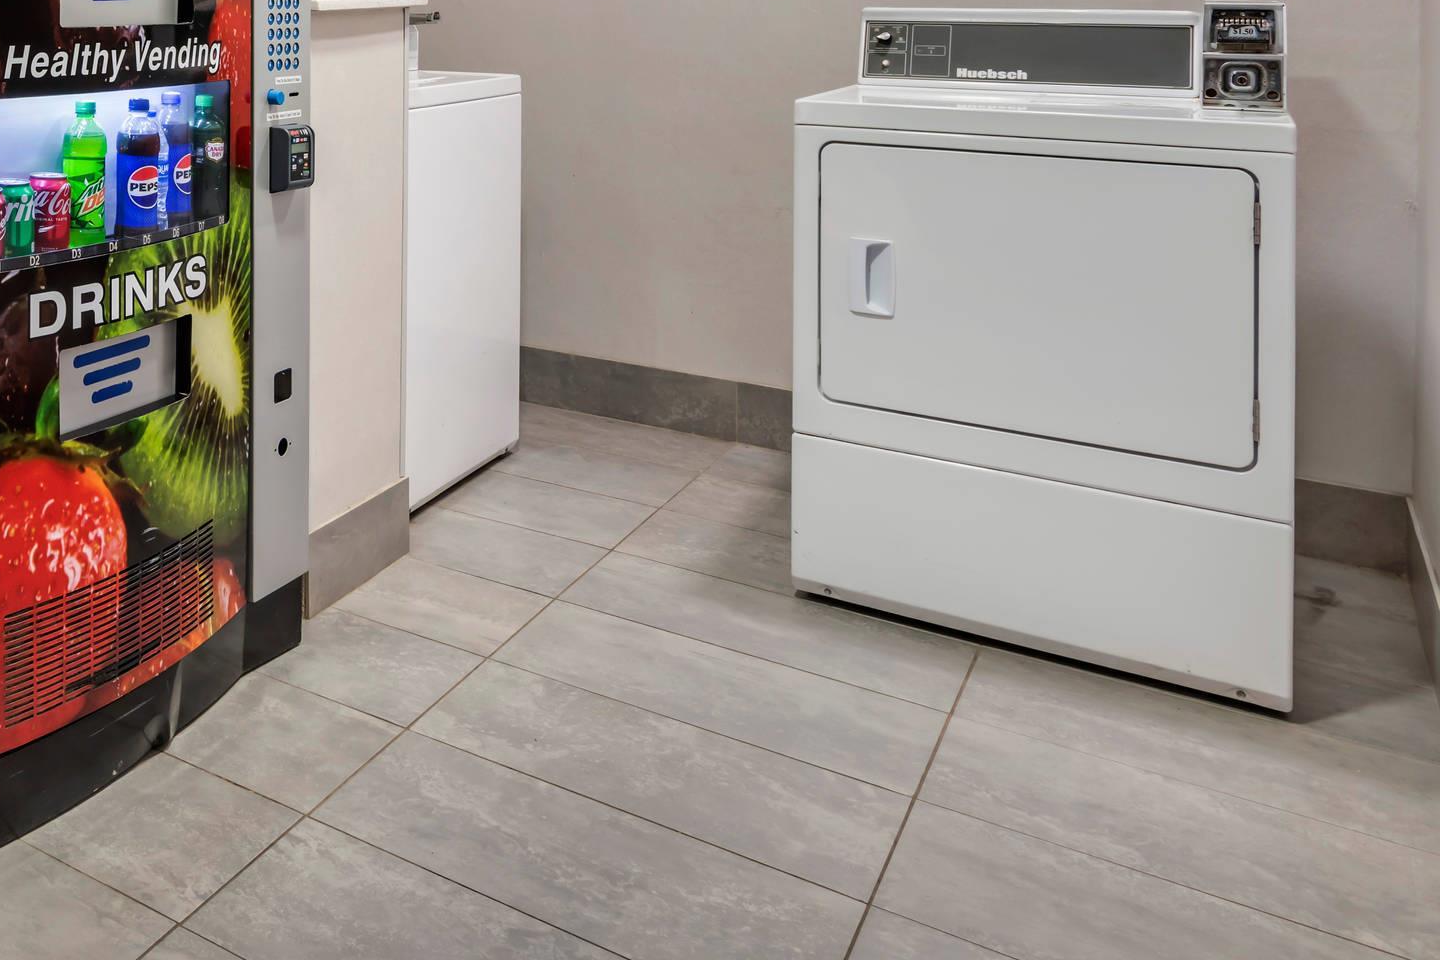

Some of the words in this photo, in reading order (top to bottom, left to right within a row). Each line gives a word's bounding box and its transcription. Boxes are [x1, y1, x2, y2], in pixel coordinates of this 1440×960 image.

[3, 42, 127, 83] Healthy
[133, 36, 222, 74] Vending
[956, 68, 1028, 80] Huebsch
[129, 181, 158, 192] PEPS
[172, 227, 180, 238] D6
[142, 234, 152, 245] D5
[108, 242, 118, 252] D4
[71, 248, 82, 259] D3
[29, 255, 40, 267] D2
[28, 254, 207, 339] DRINKS
